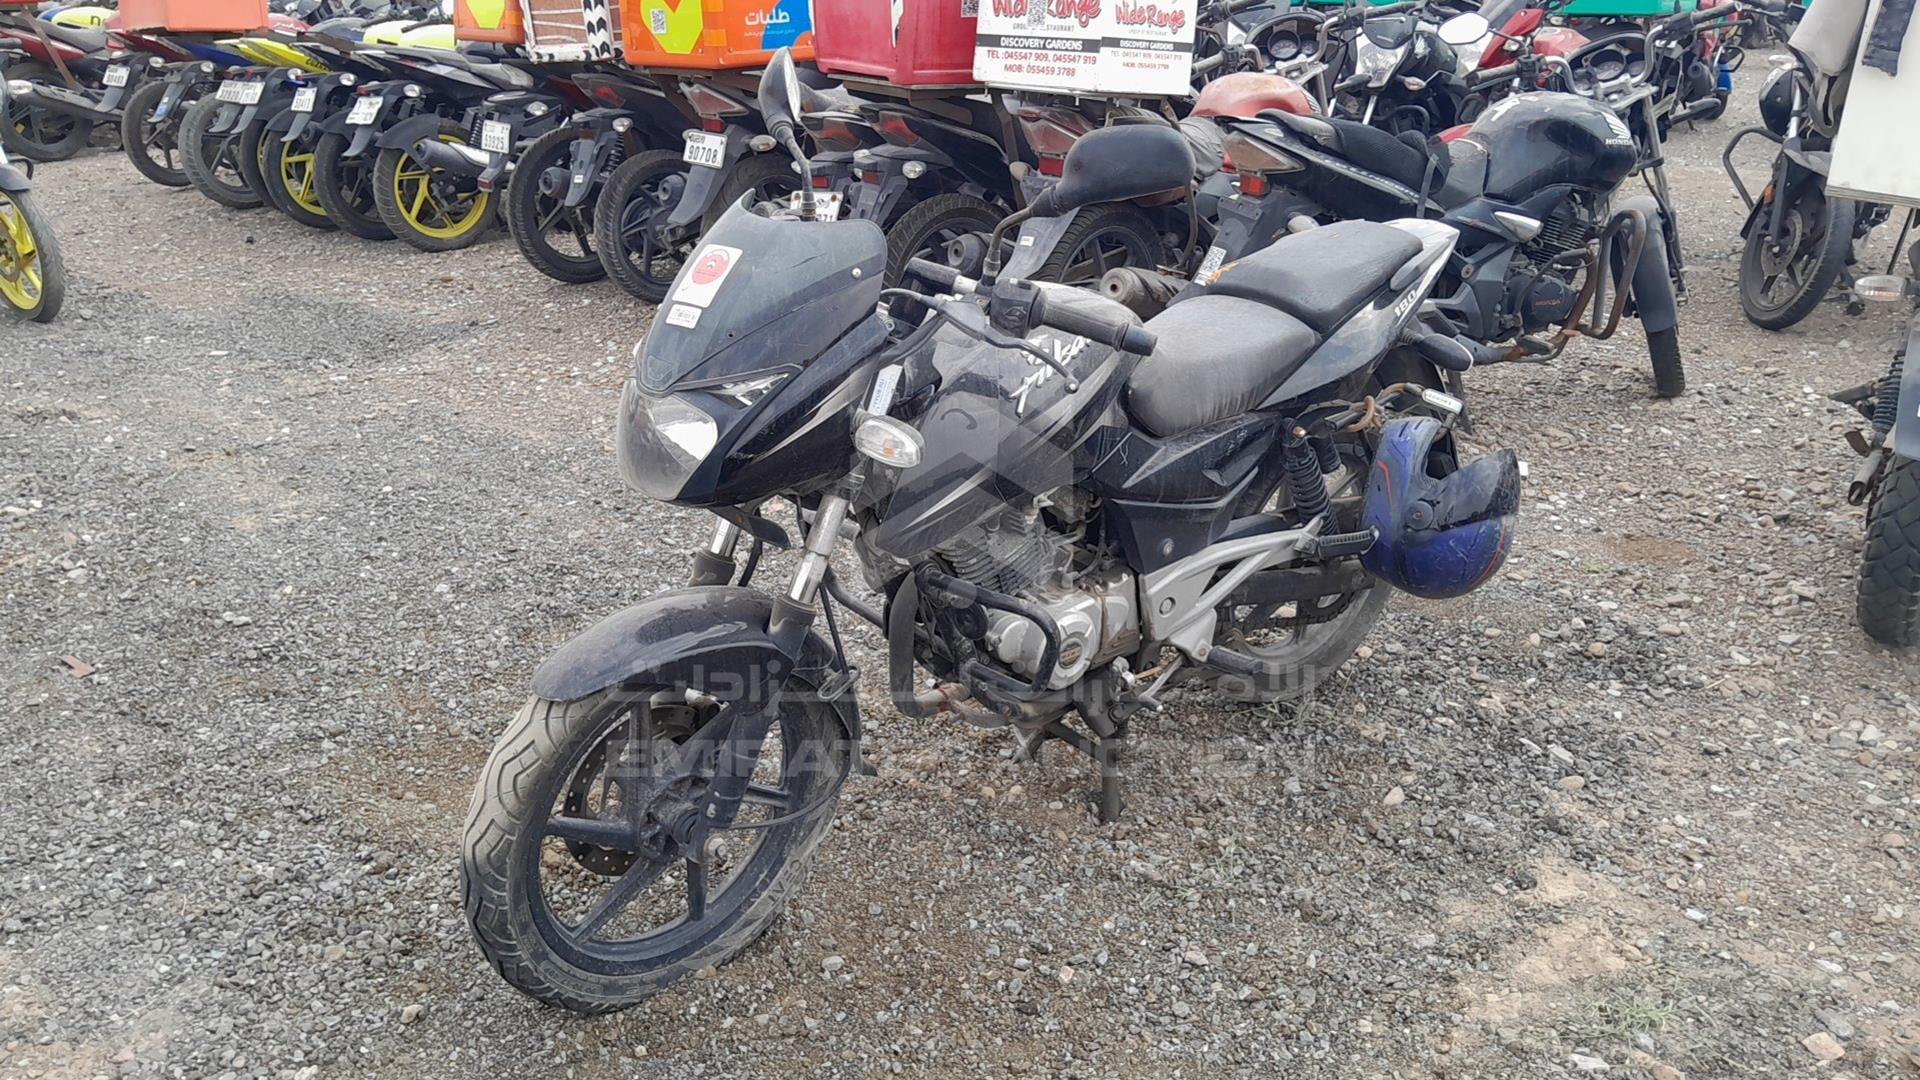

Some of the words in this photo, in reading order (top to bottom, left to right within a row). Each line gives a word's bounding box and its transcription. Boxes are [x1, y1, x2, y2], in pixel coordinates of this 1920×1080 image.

[744, 8, 790, 29] طلبات
[1047, 0, 1101, 27] ange
[1115, 0, 1146, 25] Wide
[1146, 3, 1186, 34] Range
[1000, 36, 1044, 48] DISCOVERY
[1046, 38, 1083, 51] GARDENS
[1120, 39, 1149, 49] DISCOVERY
[1150, 41, 1174, 51] GARDENS
[1052, 54, 1081, 64] 045547
[1082, 55, 1097, 65] 919
[1004, 64, 1025, 74] MOB:
[1026, 65, 1056, 76] 055459
[687, 144, 718, 164] 90708
[1394, 289, 1416, 318] 180
